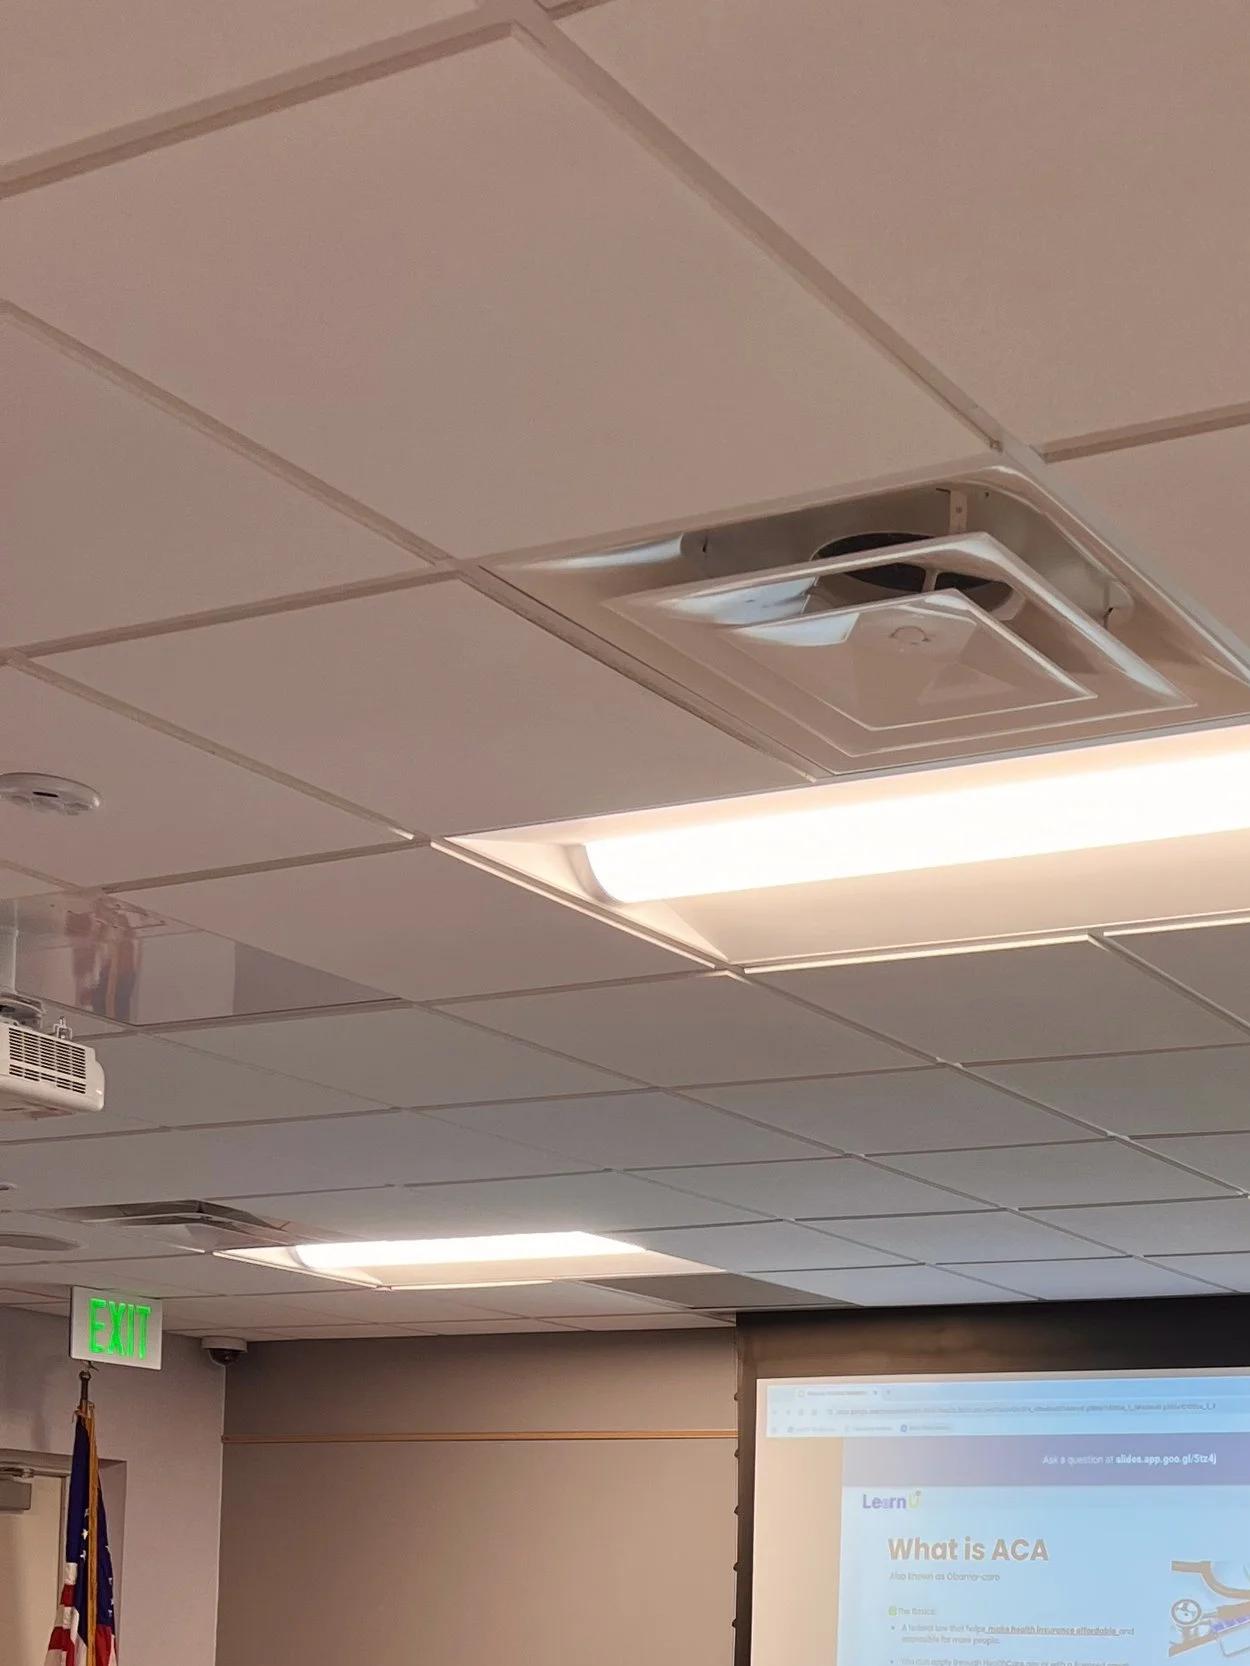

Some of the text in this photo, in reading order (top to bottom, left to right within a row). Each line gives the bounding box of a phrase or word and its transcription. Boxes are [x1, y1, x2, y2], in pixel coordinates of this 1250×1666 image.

[89, 1298, 152, 1359] EXIT
[1067, 1455, 1104, 1467] question
[888, 1536, 1049, 1561] What is ACA
